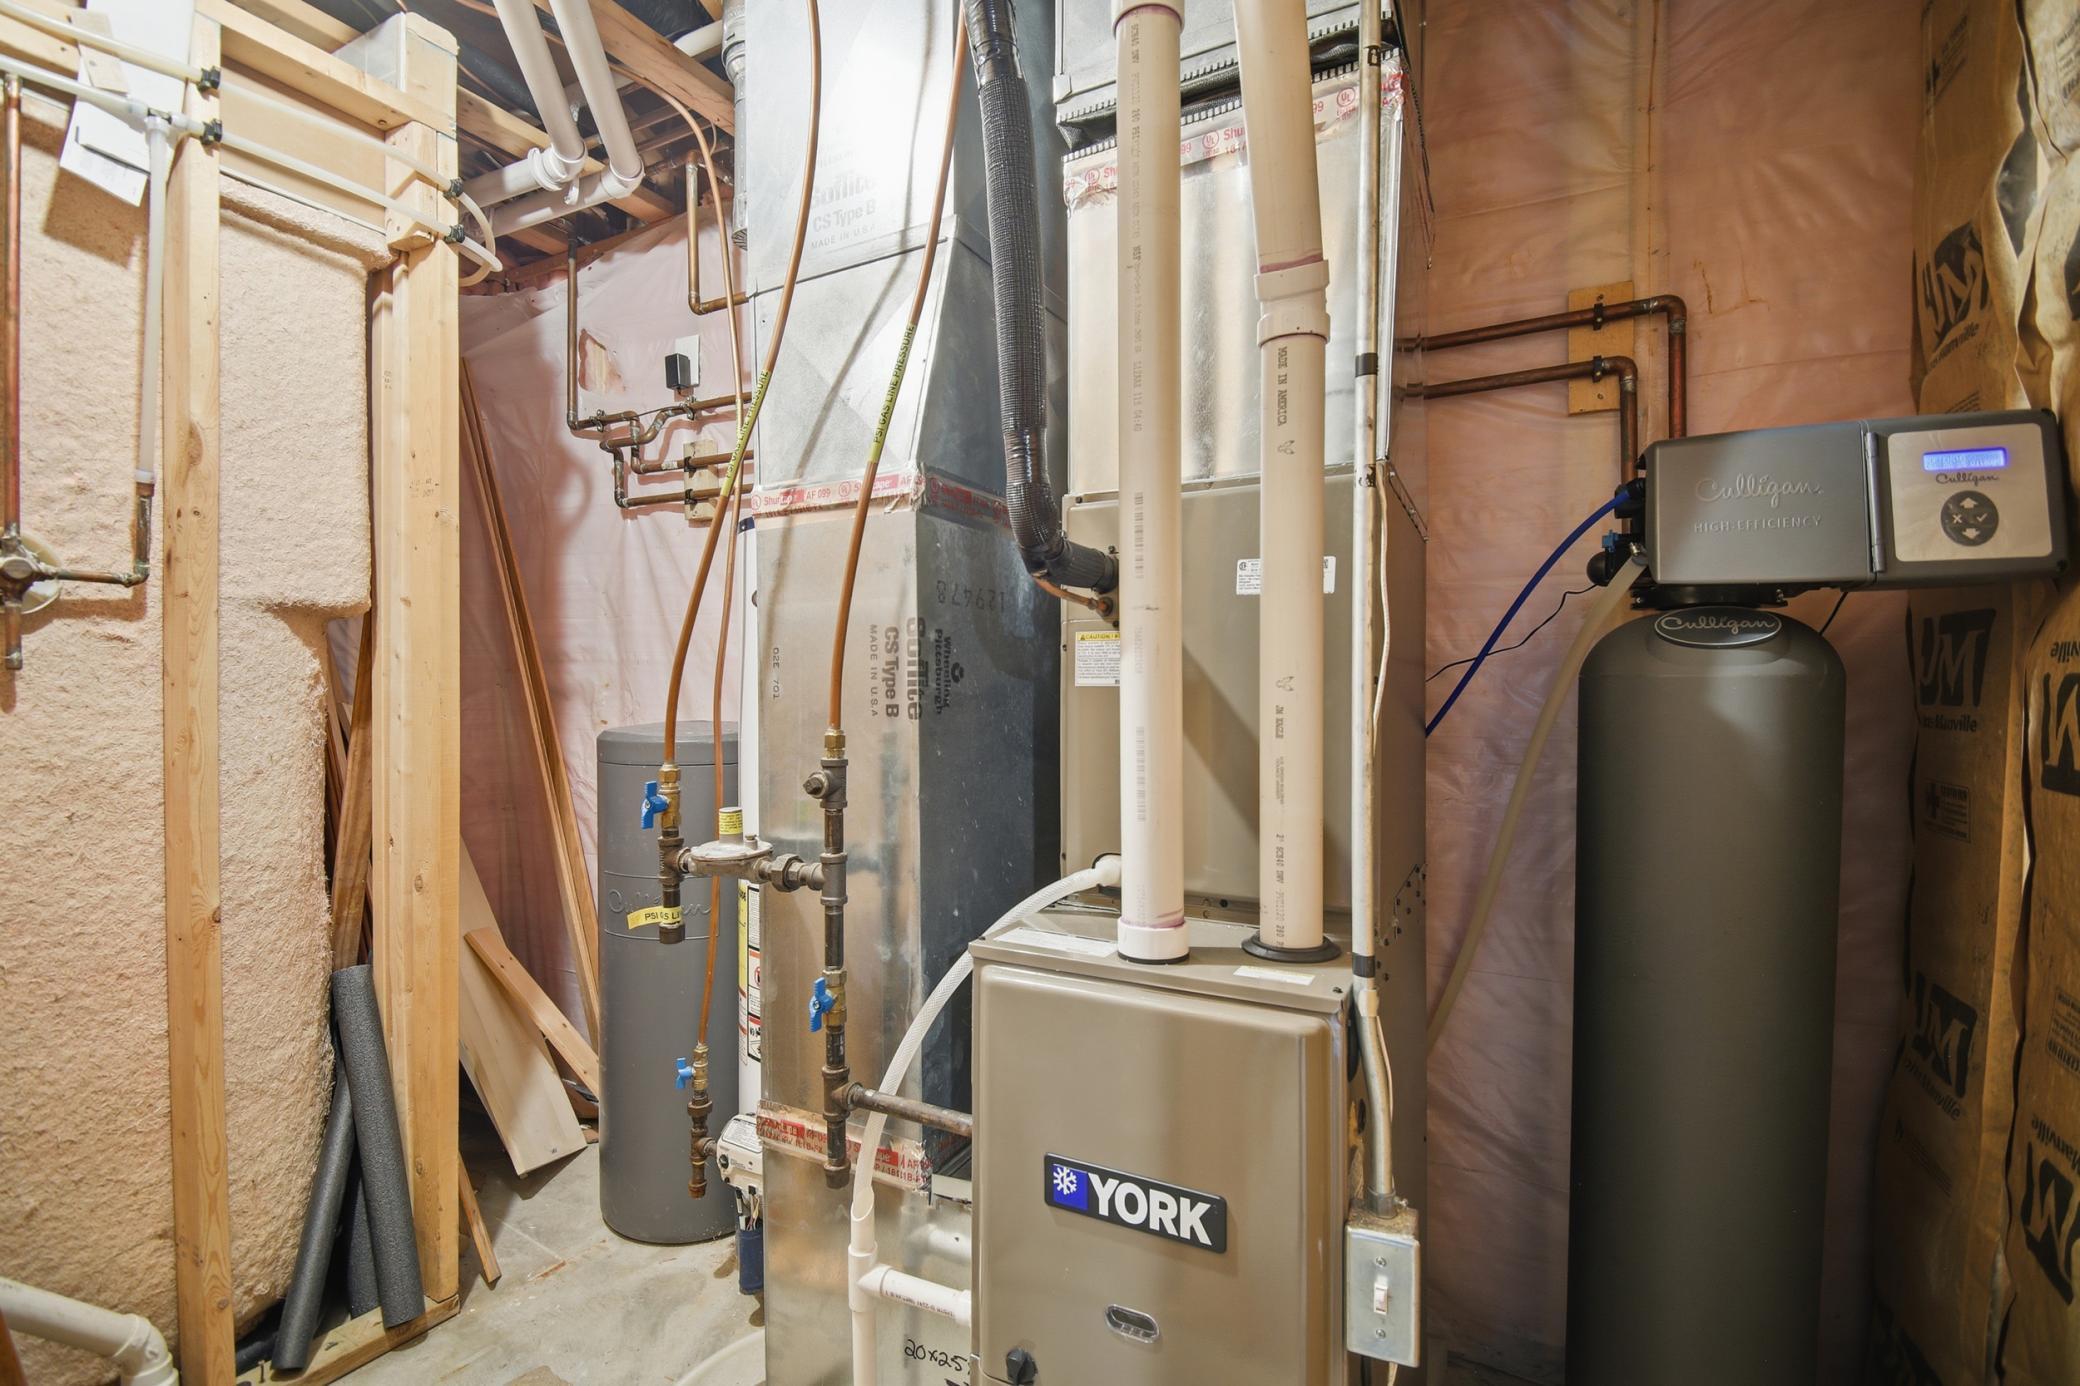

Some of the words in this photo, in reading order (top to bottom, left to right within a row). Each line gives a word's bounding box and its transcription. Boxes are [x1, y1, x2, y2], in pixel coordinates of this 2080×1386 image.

[832, 206, 863, 228] Type
[893, 324, 916, 376] PRESSURE
[1277, 346, 1288, 369] MADE
[886, 376, 901, 402] LINE
[1277, 373, 1288, 385] IN
[879, 404, 891, 426] GAS
[1277, 389, 1288, 427] AMERICA
[873, 426, 884, 444] PSI
[1695, 472, 1823, 508] Culligan
[1935, 471, 2000, 487] Culligan
[1694, 515, 1822, 533] HIGH-EFFICIENCY
[1660, 616, 1776, 635] Culligan
[869, 624, 878, 661] MADE
[884, 626, 899, 654] CS
[869, 667, 878, 680] IN
[882, 657, 899, 700] Type
[934, 628, 943, 715] Pittsburgh
[943, 635, 952, 708] Wheeling
[886, 703, 899, 718] B
[644, 911, 659, 921] PSI
[1087, 1172, 1213, 1246] YORK
[904, 1338, 971, 1375] 20x25
